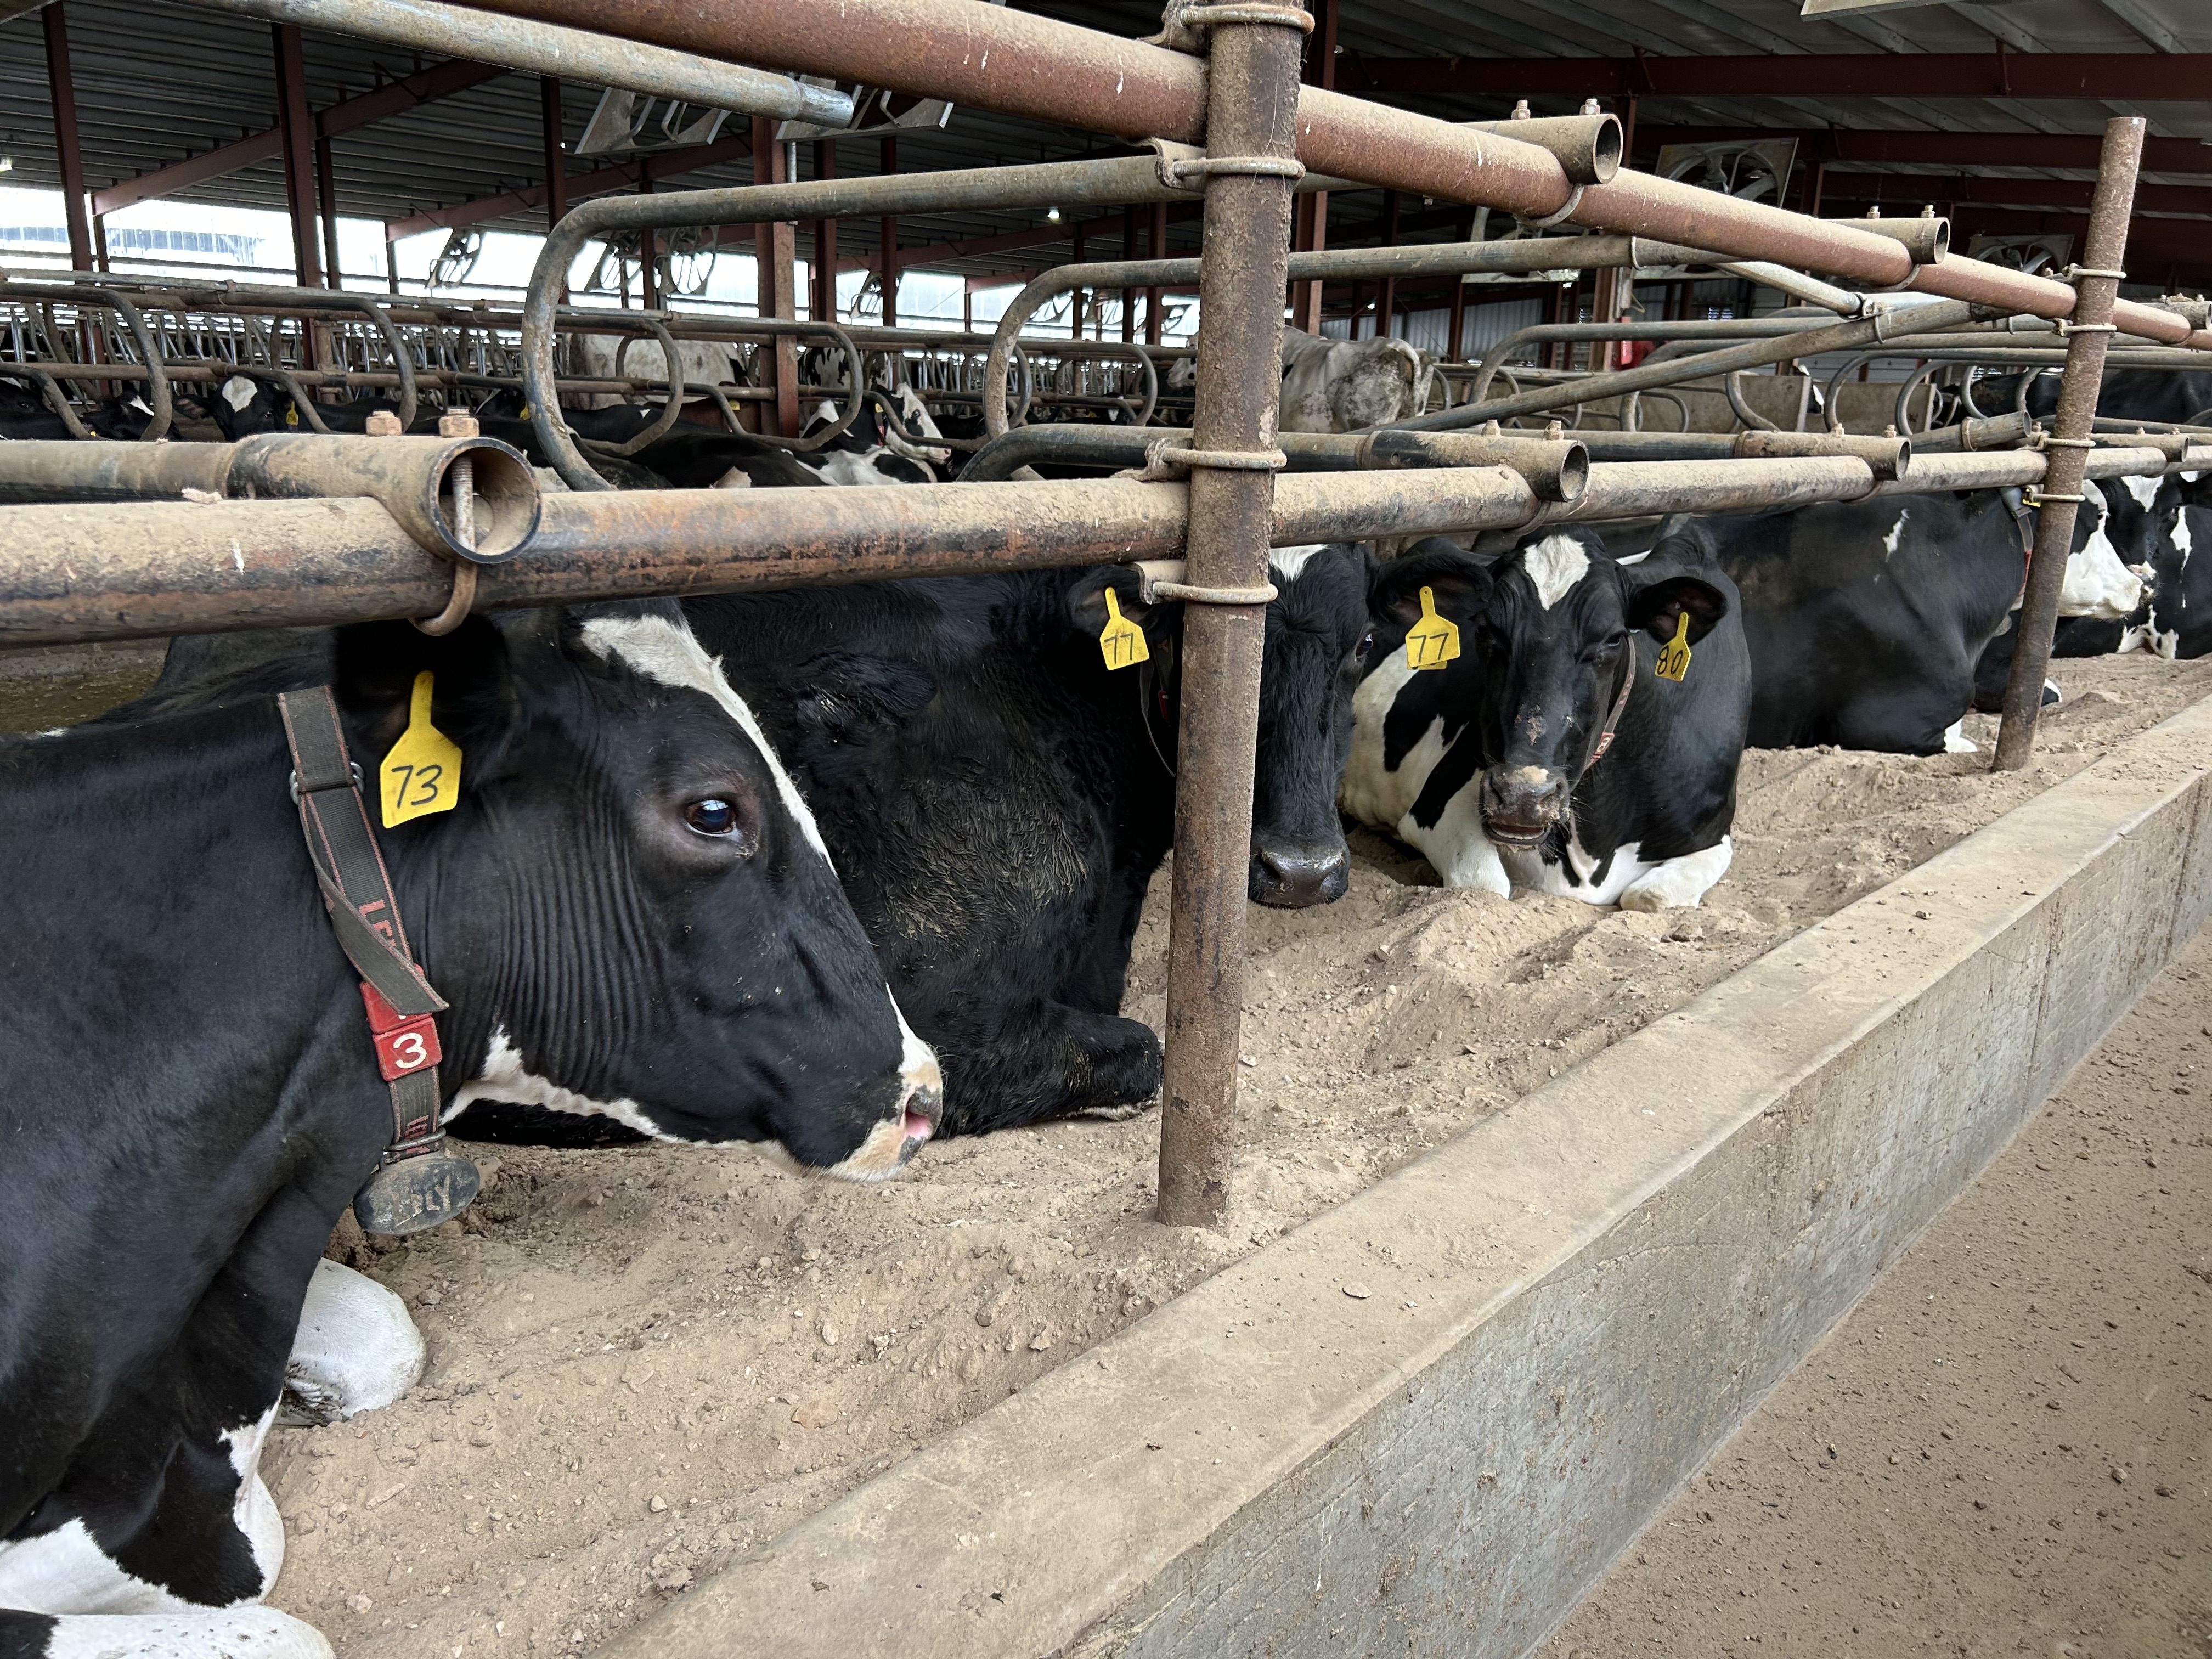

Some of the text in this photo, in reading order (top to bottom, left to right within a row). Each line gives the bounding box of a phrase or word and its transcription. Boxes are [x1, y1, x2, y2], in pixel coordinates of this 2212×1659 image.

[1104, 633, 1133, 664] 77
[1409, 633, 1449, 664] 77
[1657, 645, 1683, 674] 80
[391, 764, 442, 809] 73
[393, 1032, 427, 1069] 3
